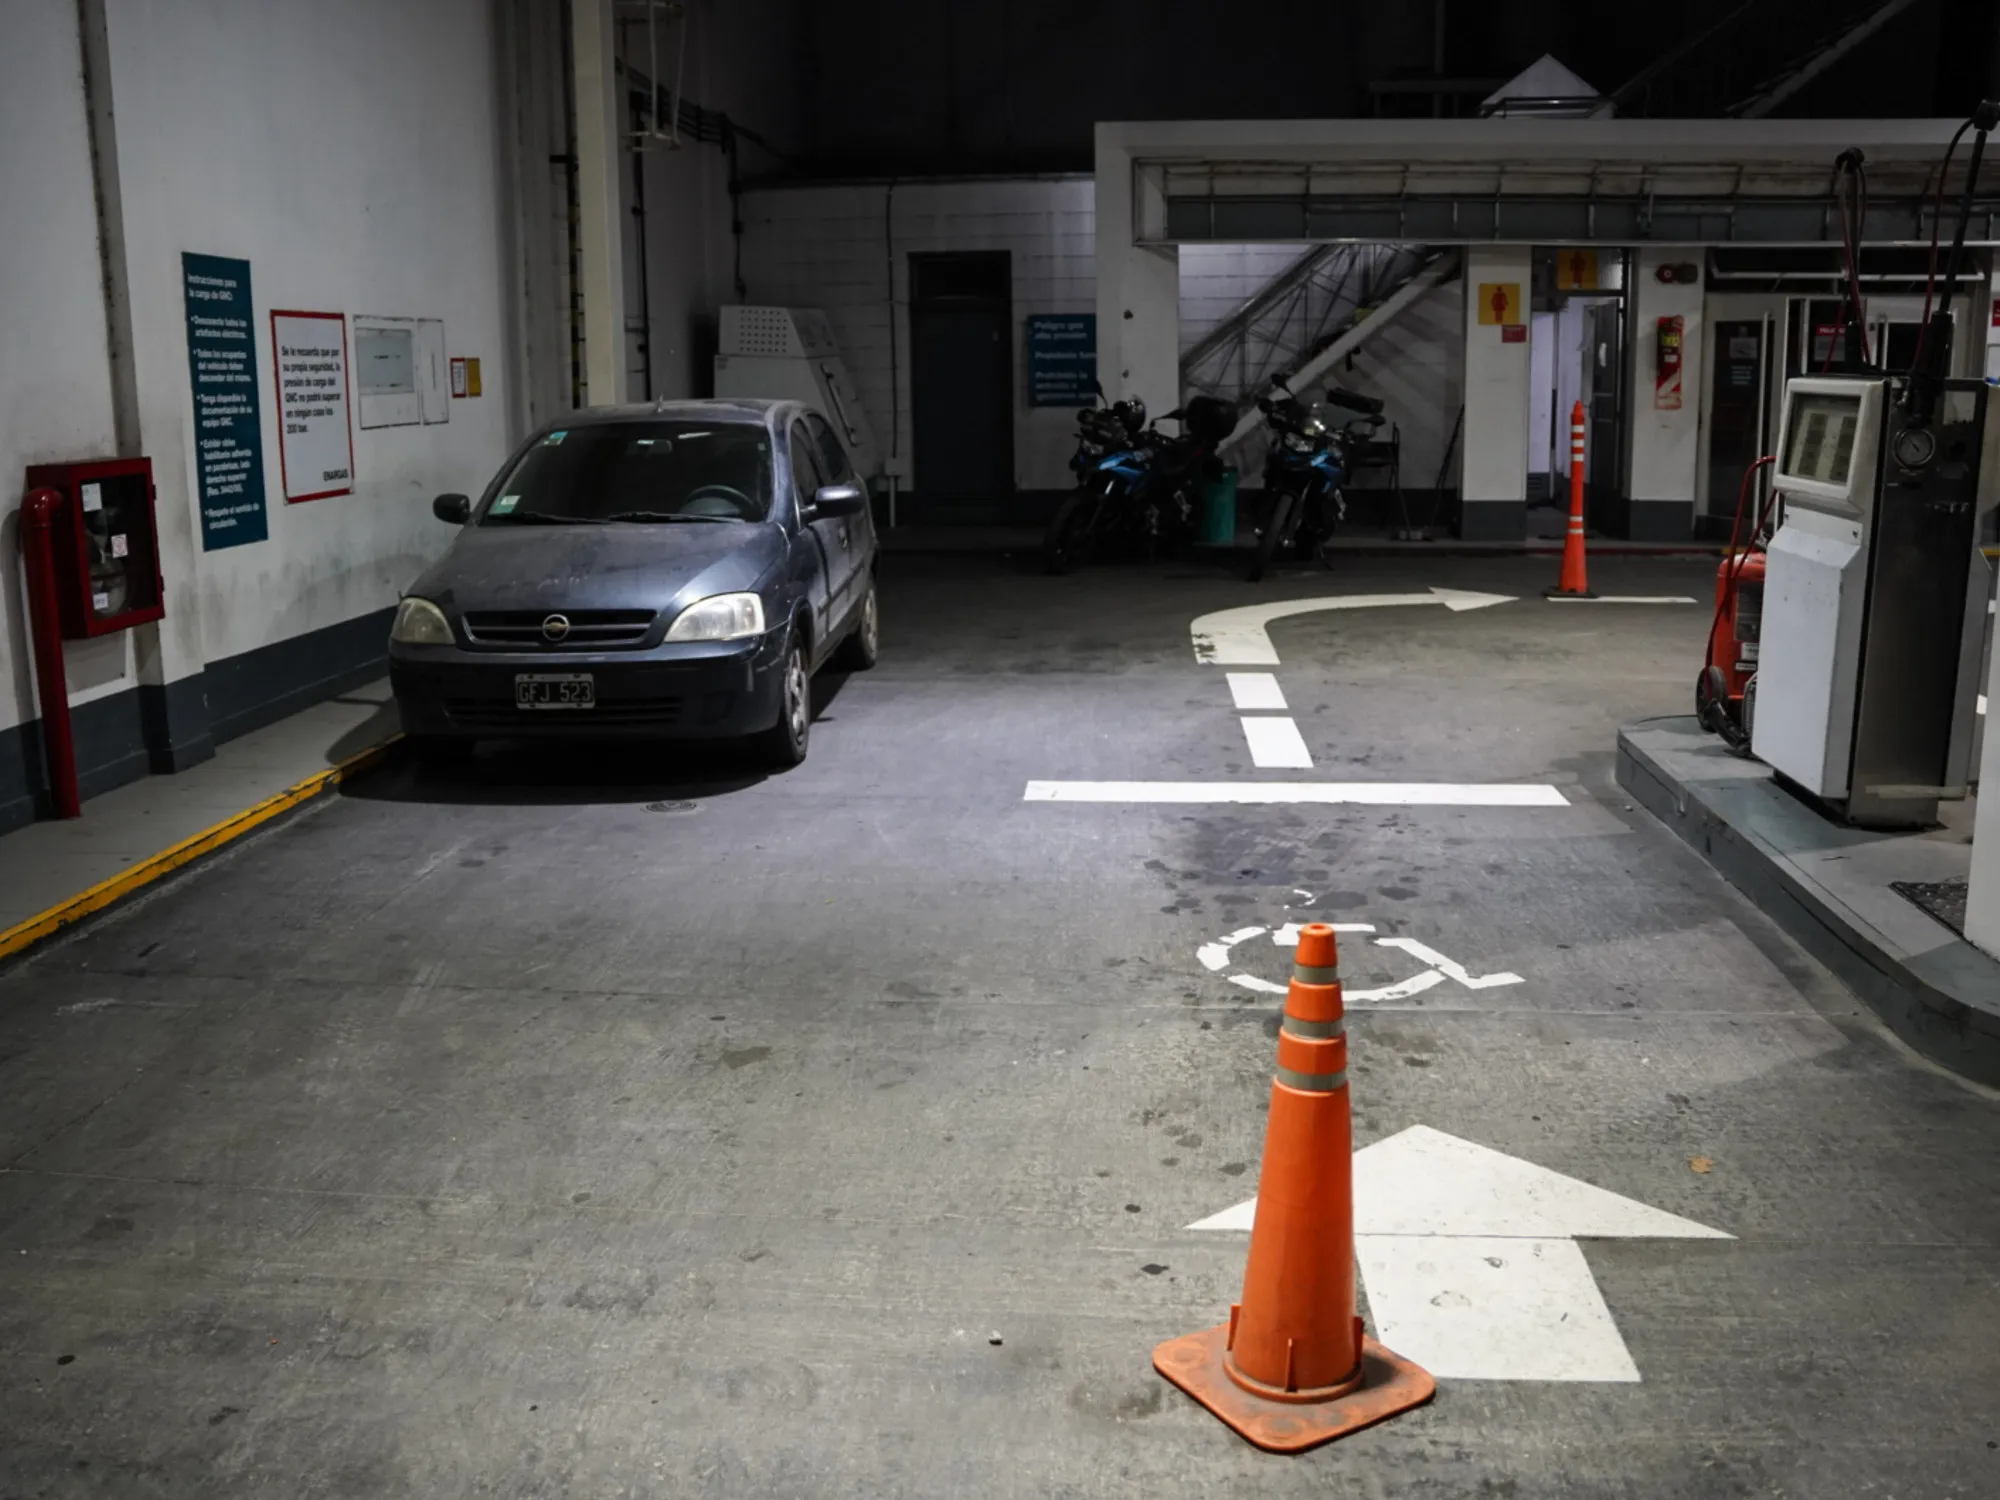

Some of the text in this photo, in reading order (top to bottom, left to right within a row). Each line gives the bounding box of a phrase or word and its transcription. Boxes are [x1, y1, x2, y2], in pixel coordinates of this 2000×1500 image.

[281, 345, 340, 358] Se le recuerda que por
[291, 362, 307, 373] propia
[336, 363, 341, 371] la
[305, 377, 312, 386] de
[313, 378, 326, 388] carga
[328, 377, 336, 386] del
[325, 407, 333, 415] los
[287, 424, 297, 434] 200
[519, 683, 591, 702] GFJ 523
